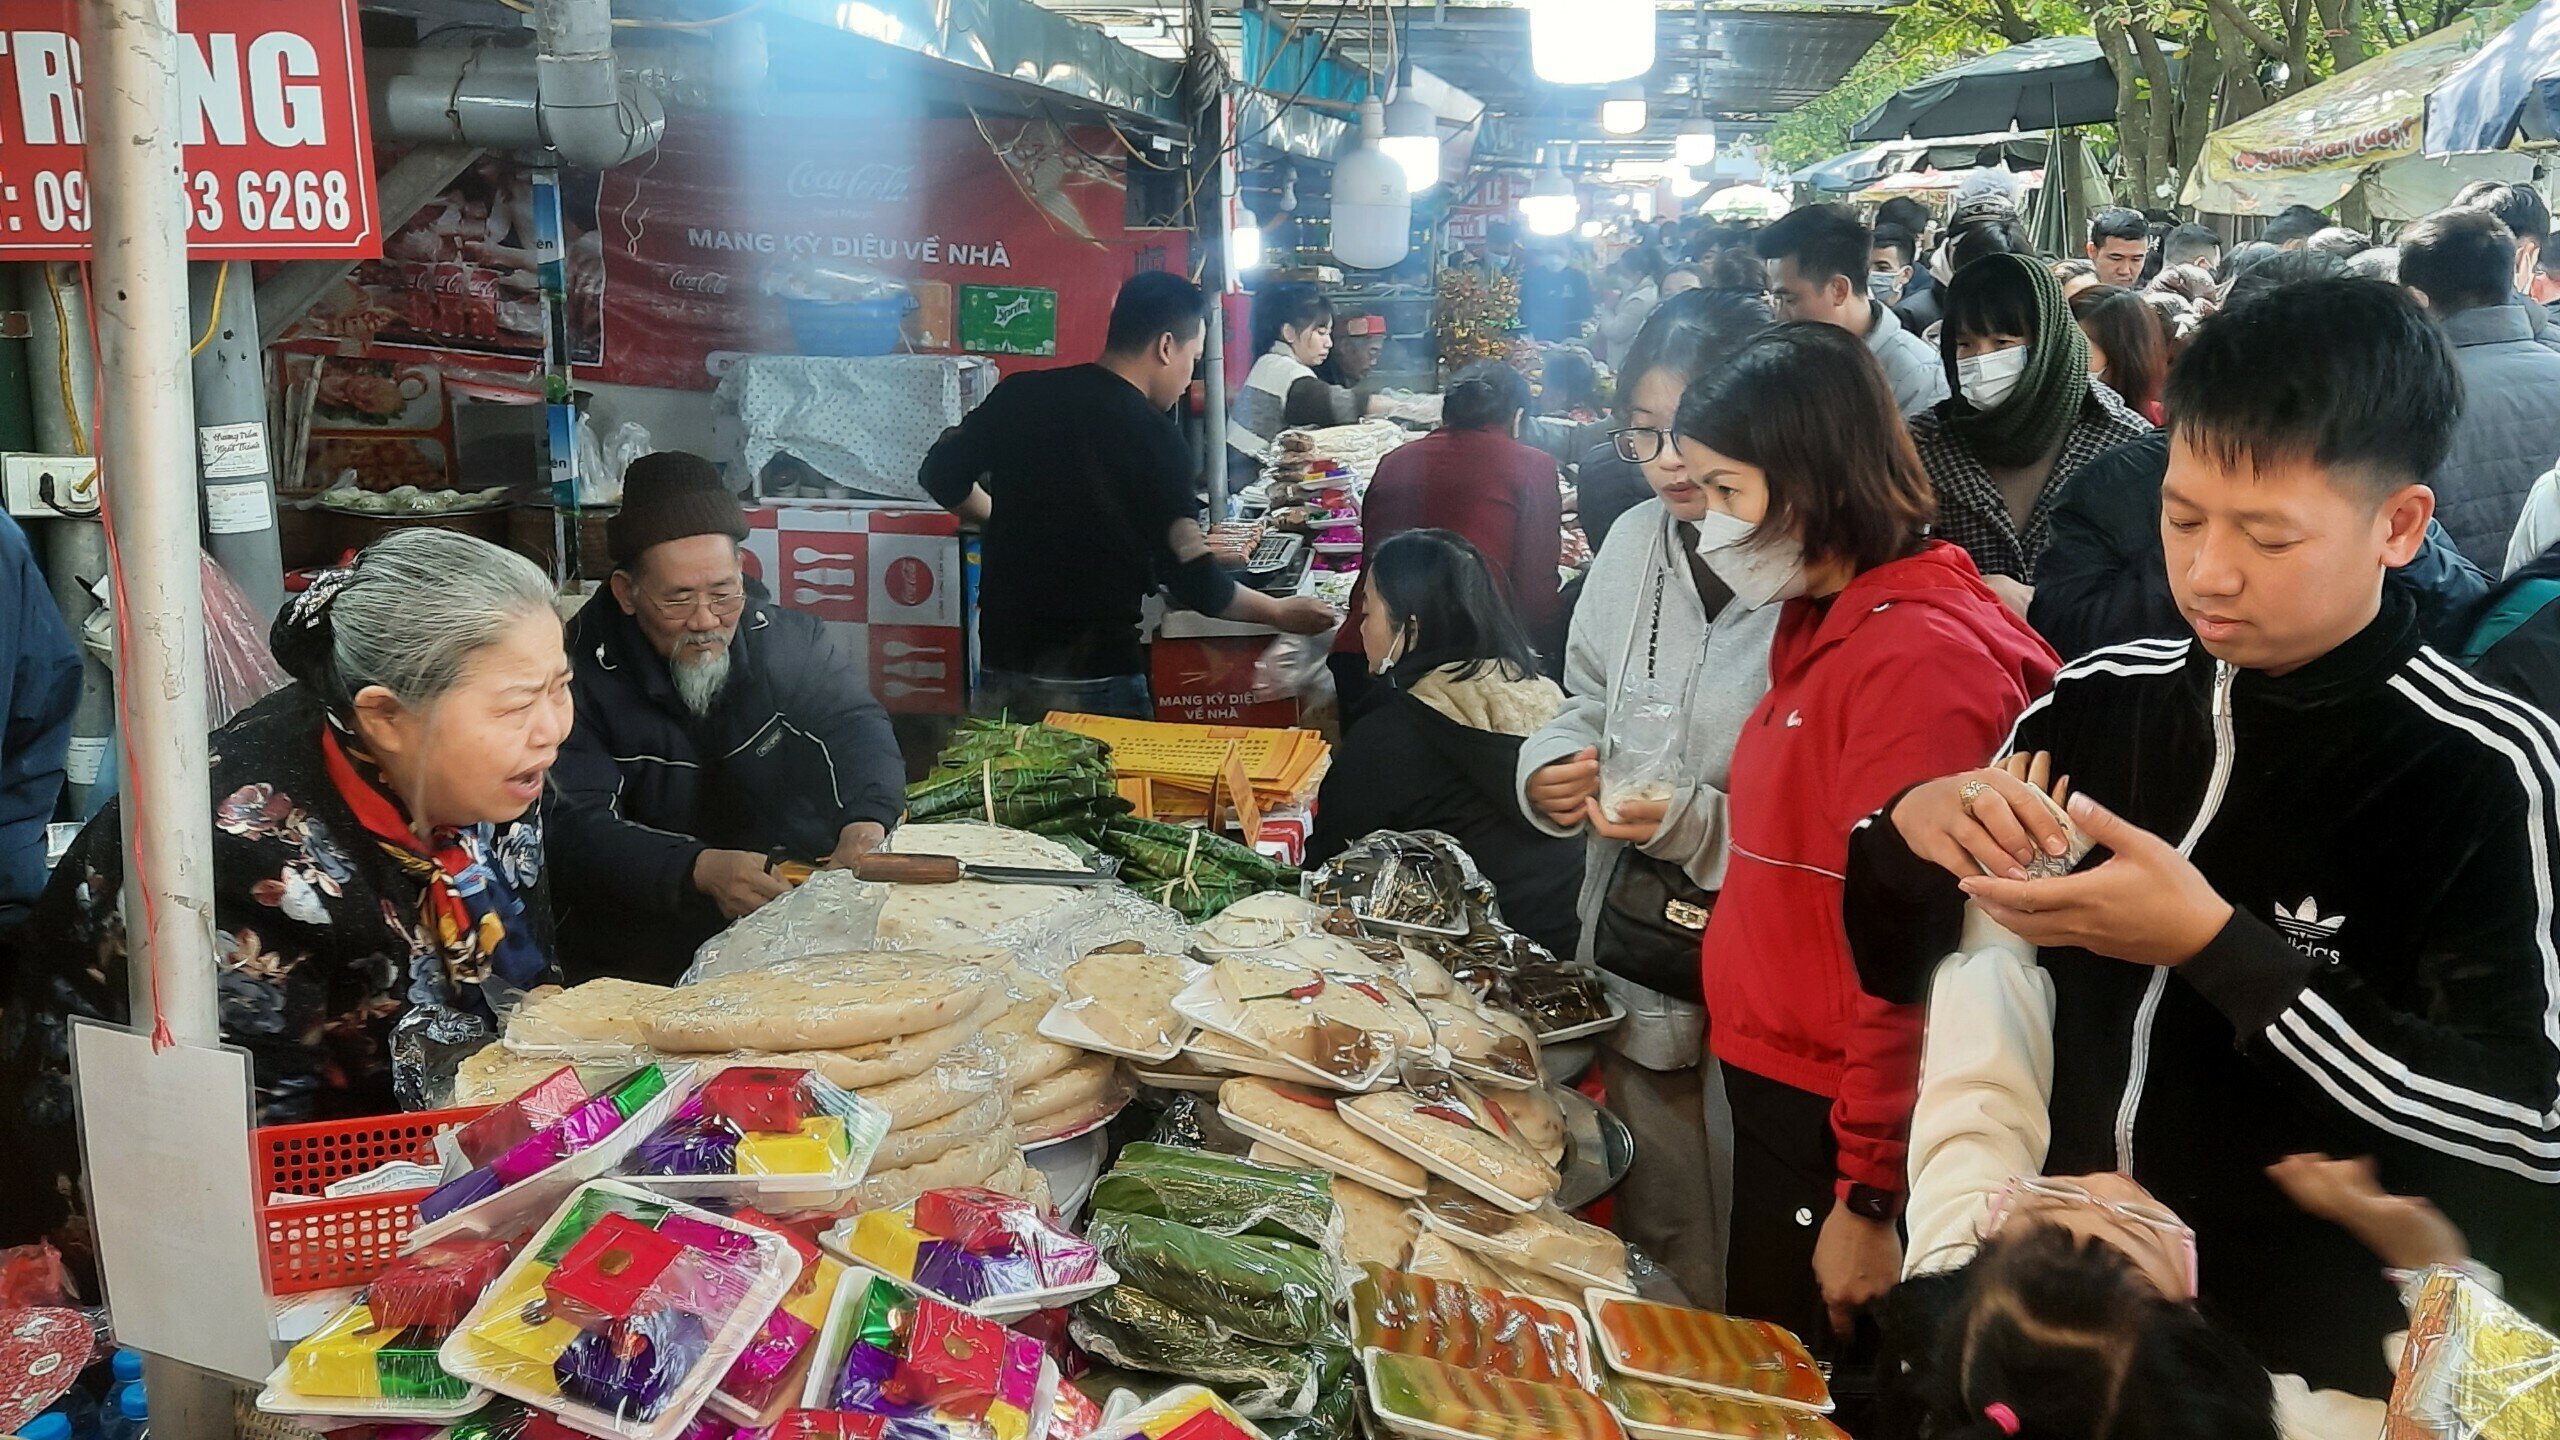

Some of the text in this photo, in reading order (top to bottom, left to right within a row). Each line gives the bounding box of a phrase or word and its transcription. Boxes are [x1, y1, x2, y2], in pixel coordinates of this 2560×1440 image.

[0, 31, 326, 147] RNG
[237, 170, 350, 231] 6268
[688, 227, 775, 252] MANG
[832, 233, 898, 264] DIỆU
[905, 235, 940, 263] VỀ
[948, 241, 1010, 268] NHÀ
[997, 300, 1027, 322] Sprite
[1159, 695, 1203, 707] MANG
[1206, 692, 1226, 705] KỲ
[1185, 706, 1239, 720] VỀ NHÀ
